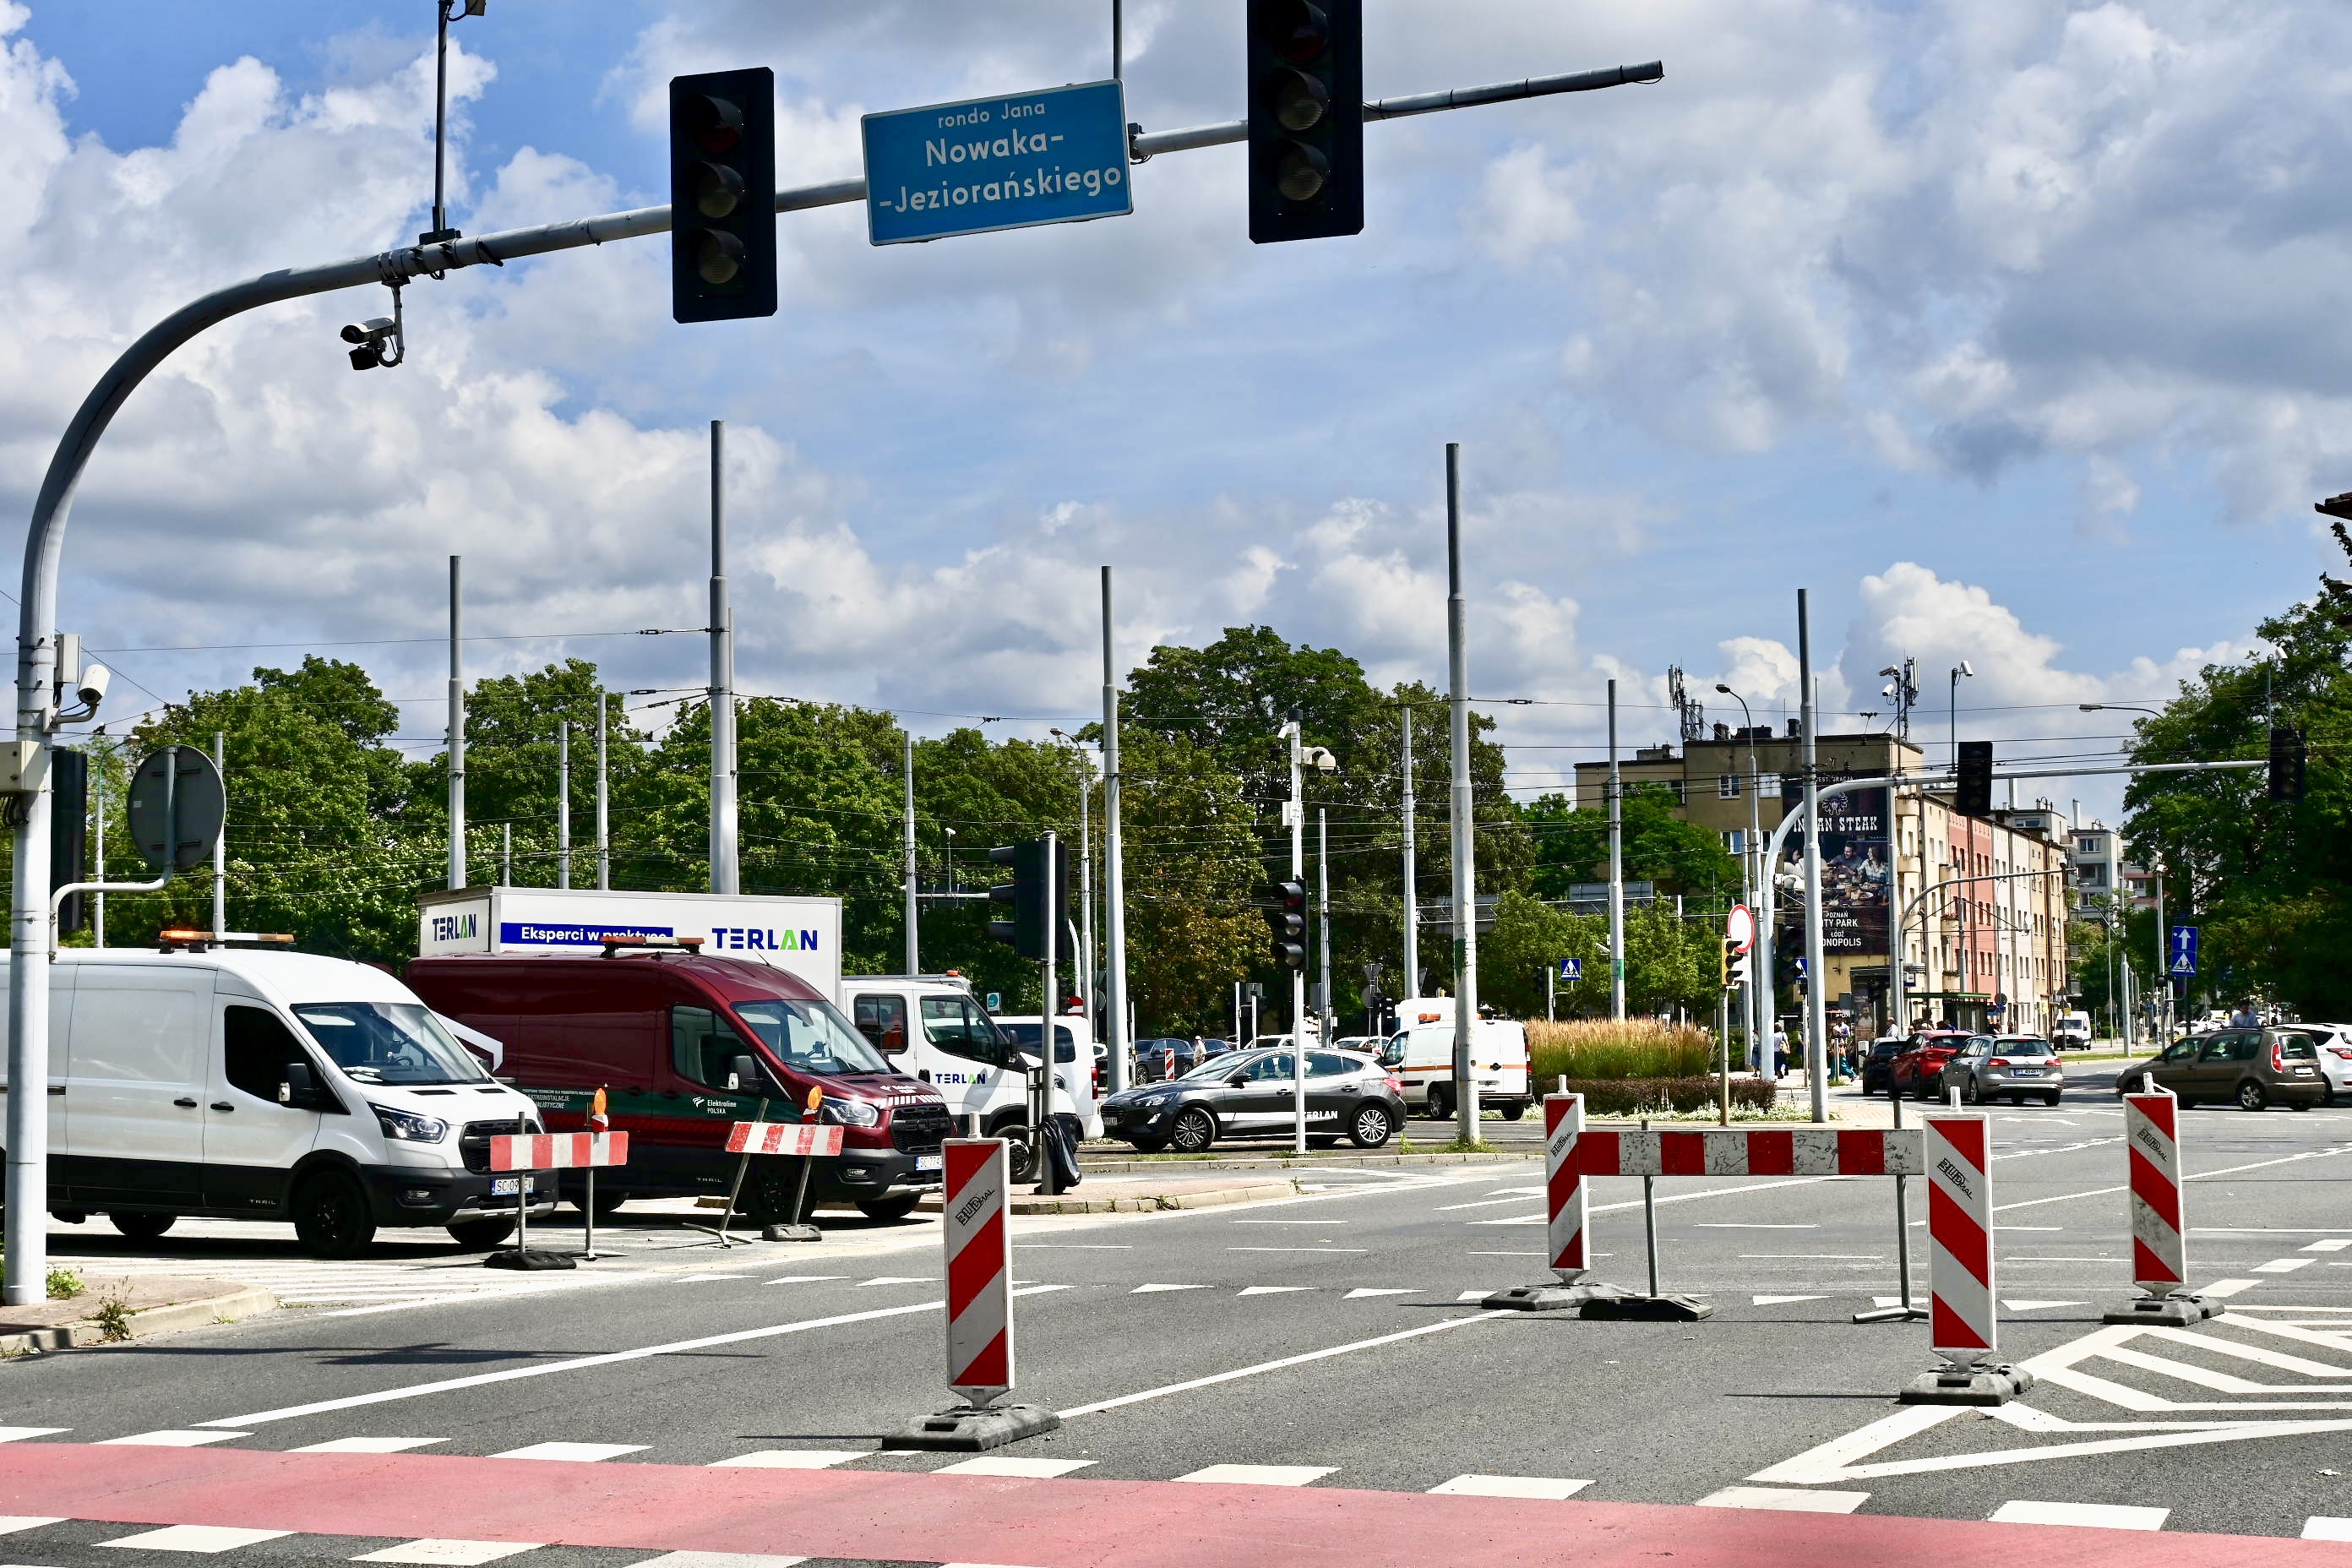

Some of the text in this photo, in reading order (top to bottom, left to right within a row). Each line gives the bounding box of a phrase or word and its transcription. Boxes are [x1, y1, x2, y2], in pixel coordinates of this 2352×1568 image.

[938, 102, 1047, 128] rondo Jana
[925, 128, 1064, 167] Nowaka-
[879, 166, 1121, 213] -Jeziorańskiego
[1793, 816, 1877, 832] INAN STEAK
[1826, 910, 1848, 918] POZNAŃ
[432, 913, 476, 942] TERLAN
[1836, 918, 1859, 928] PARK
[521, 926, 584, 944] Eksperci
[587, 931, 600, 941] w
[711, 928, 818, 950] TERLAN
[1822, 938, 1862, 947] ONOPOLIS
[935, 1073, 986, 1084] TERLAN
[707, 1099, 738, 1108] Elektroline
[1304, 1110, 1338, 1120] ERLAN
[497, 1179, 533, 1192] SC 09EV
